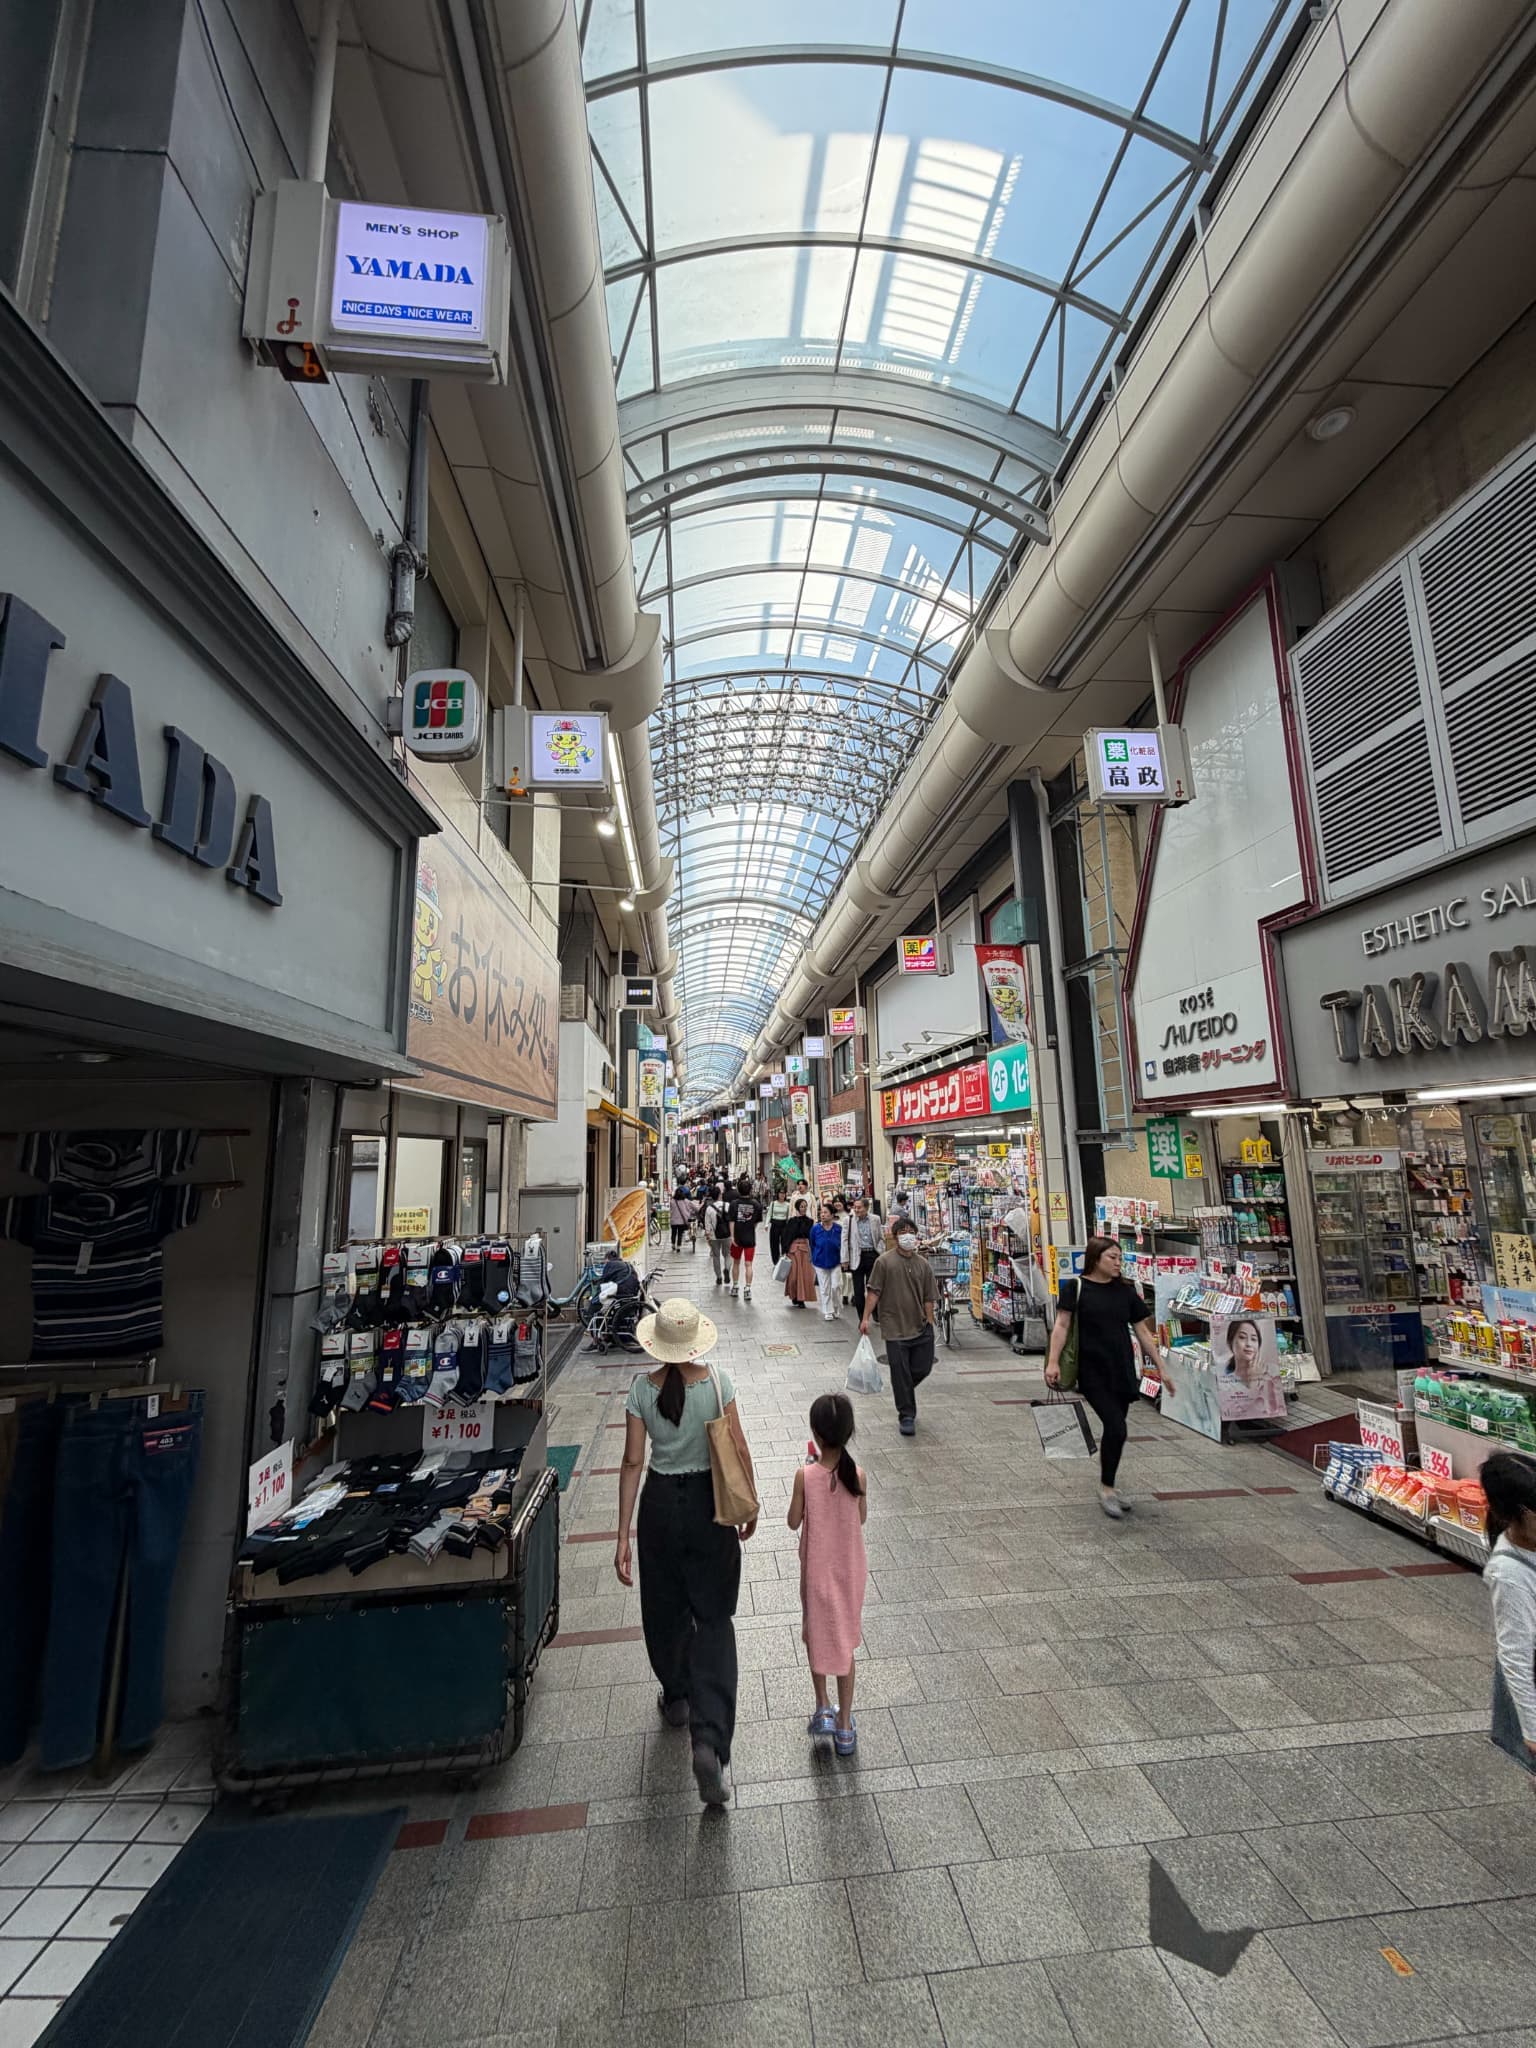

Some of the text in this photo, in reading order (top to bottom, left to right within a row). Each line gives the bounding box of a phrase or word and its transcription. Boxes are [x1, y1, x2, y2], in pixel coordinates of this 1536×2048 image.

[366, 222, 460, 240] MEN'S SHOP
[346, 254, 474, 285] YAMADA
[416, 698, 464, 710] JCB
[413, 732, 464, 740] JCB CARDS
[1130, 746, 1156, 756] 化粧品
[1108, 766, 1160, 787] 高政
[1361, 898, 1470, 956] ESTHETIC
[449, 914, 549, 1069] お休み処
[1160, 1012, 1238, 1050] SHISEIDO
[994, 1071, 1006, 1092] 2F
[1012, 1059, 1030, 1094] 化
[902, 1073, 960, 1120] サンドラッグ
[1150, 1122, 1180, 1174] 薬
[437, 1408, 477, 1419] 3足 税込
[1381, 1434, 1402, 1459] 298
[1431, 1451, 1450, 1476] 356
